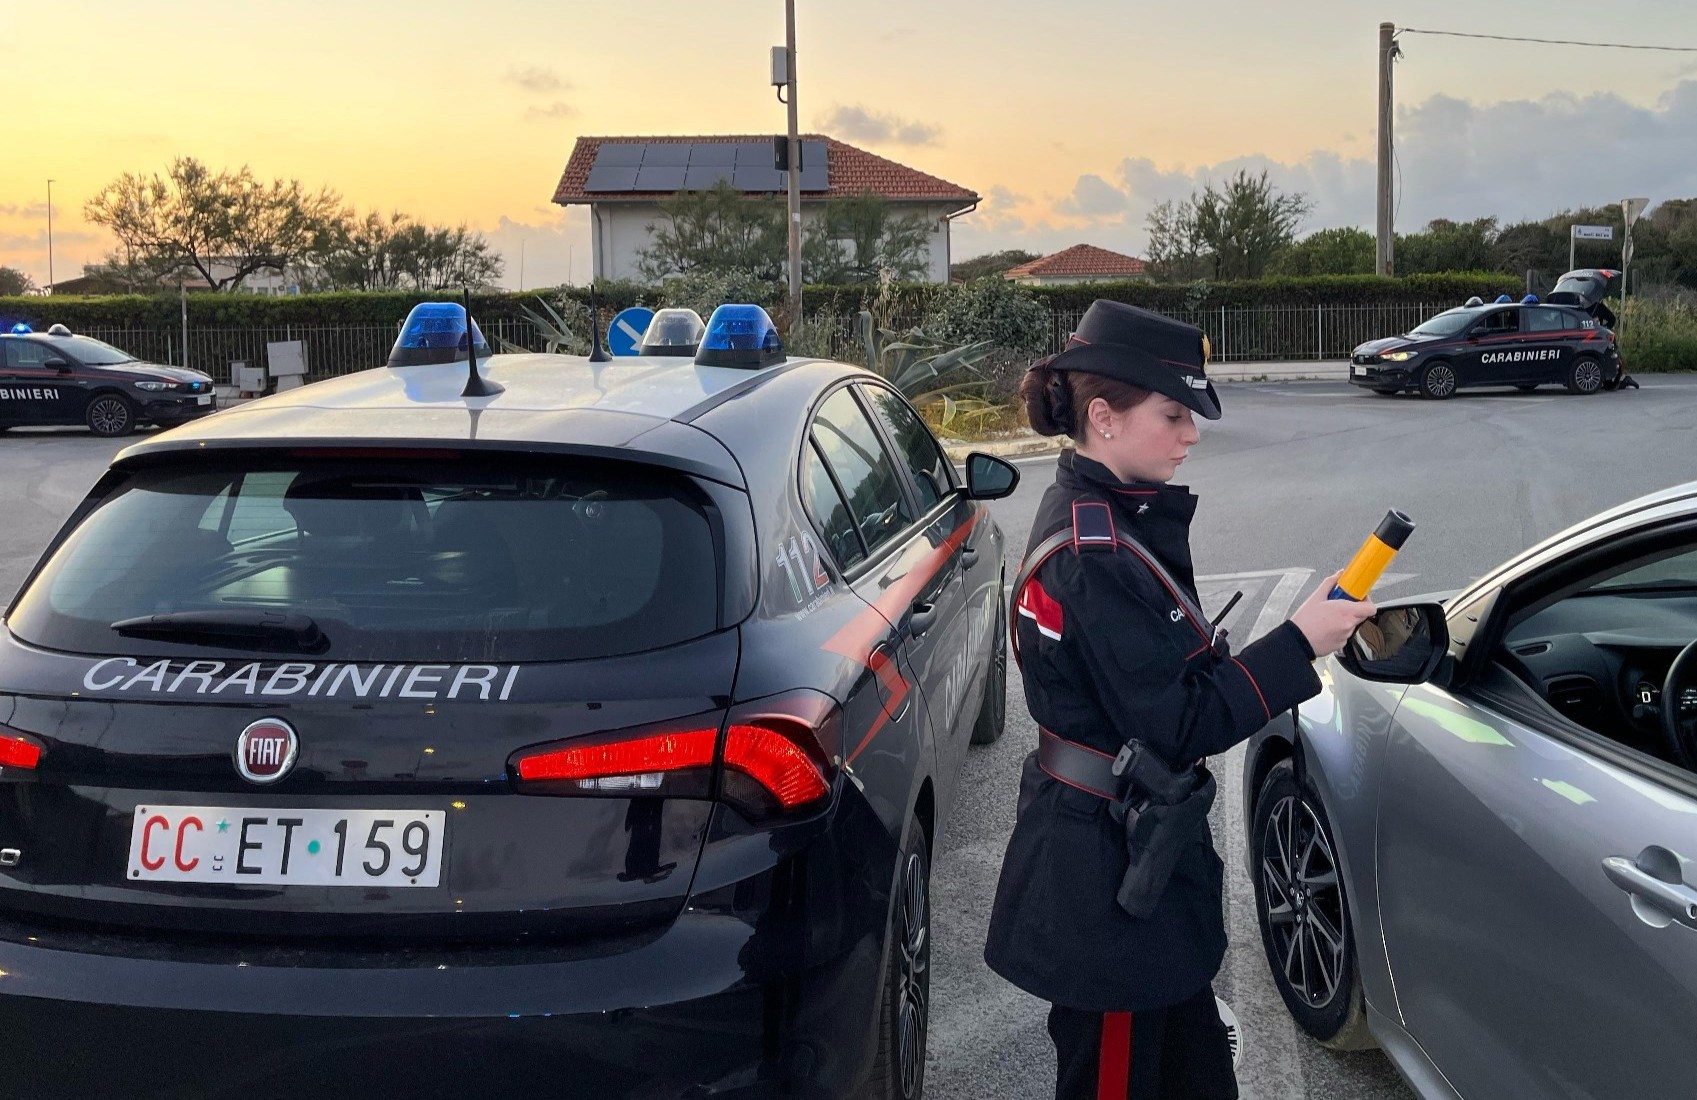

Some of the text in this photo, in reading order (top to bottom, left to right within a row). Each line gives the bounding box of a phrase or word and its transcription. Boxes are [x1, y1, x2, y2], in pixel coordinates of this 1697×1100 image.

[1582, 320, 1594, 329] 112
[1481, 349, 1561, 364] CARABINIERI
[0, 388, 59, 400] BINIERI
[776, 531, 829, 604] 112
[84, 657, 521, 701] CARABINIERI
[249, 737, 285, 766] FIAT
[141, 815, 430, 877] CC ET 159
